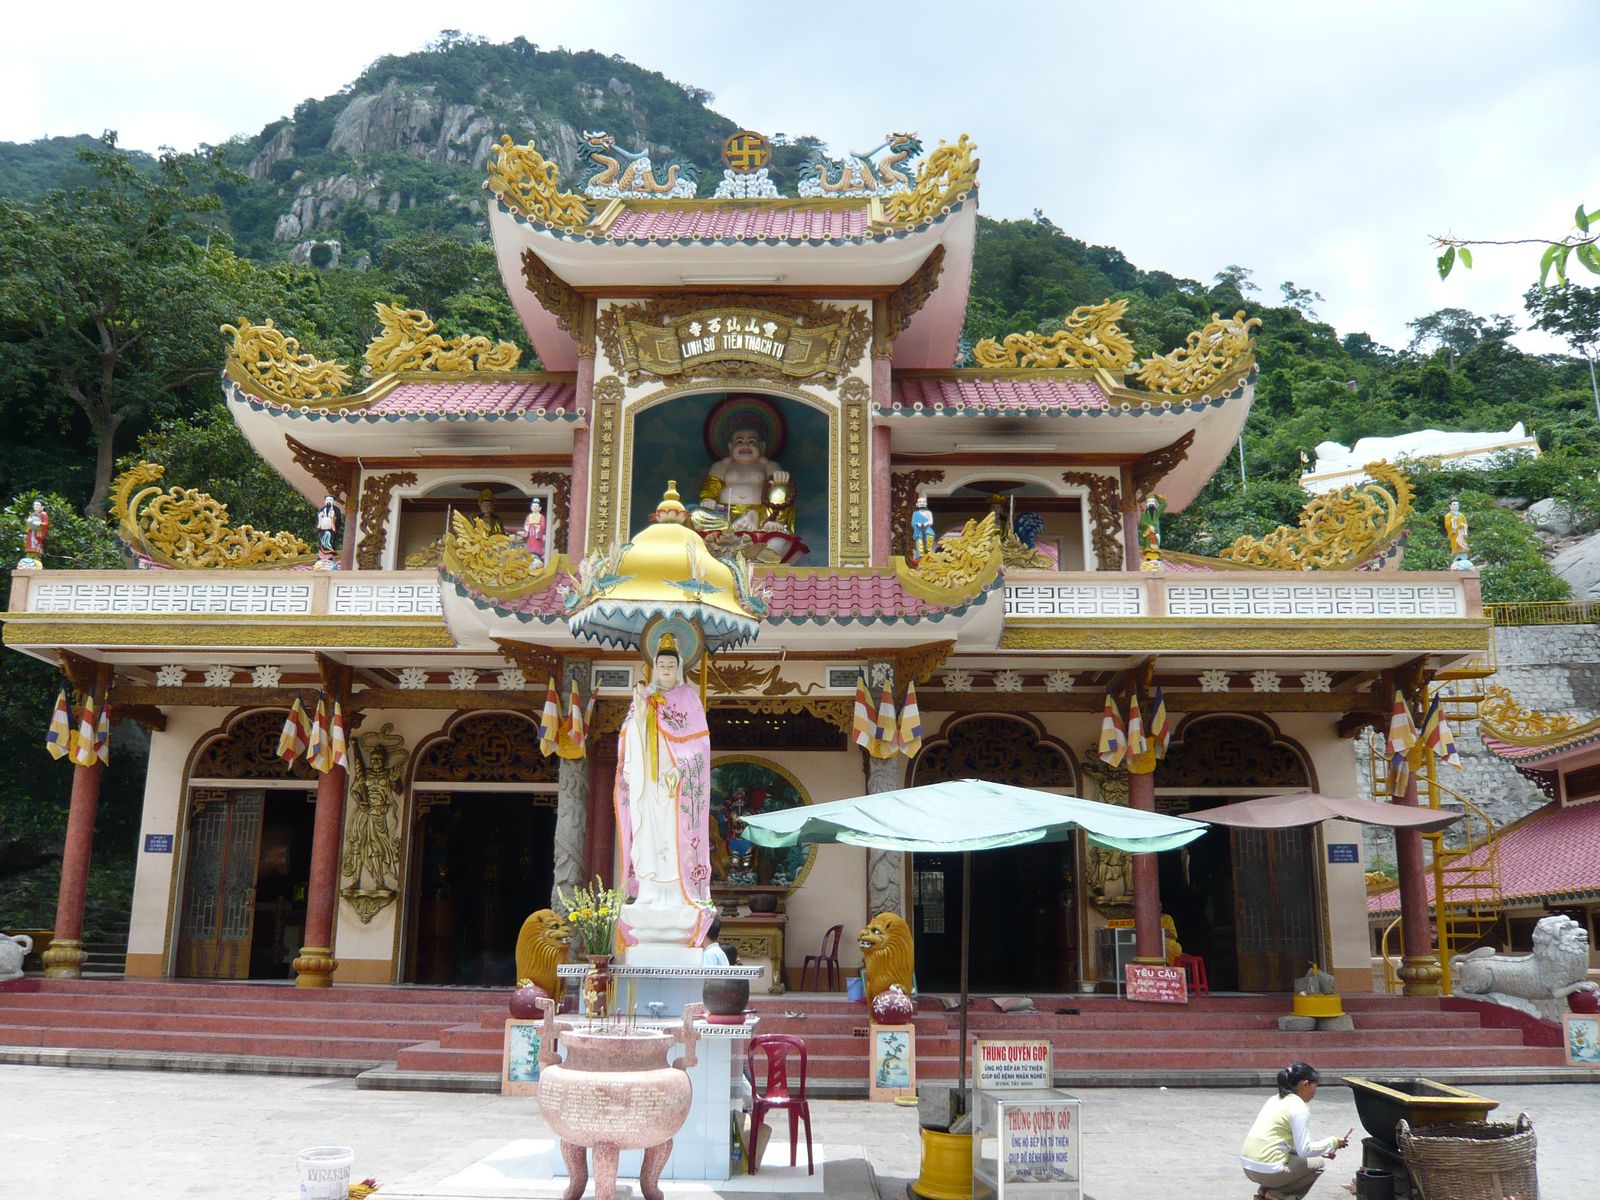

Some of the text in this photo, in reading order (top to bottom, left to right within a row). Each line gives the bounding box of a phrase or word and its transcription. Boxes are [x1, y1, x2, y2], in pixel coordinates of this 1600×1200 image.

[682, 340, 703, 358] LINH
[723, 332, 743, 350] TIÊN
[745, 335, 773, 354] THẠCH
[772, 341, 785, 360] TỰ
[1135, 967, 1154, 977] YÊU
[981, 1044, 1006, 1061] THÙNG
[1033, 1043, 1048, 1061] GÓP
[1057, 1106, 1071, 1130] GÓP
